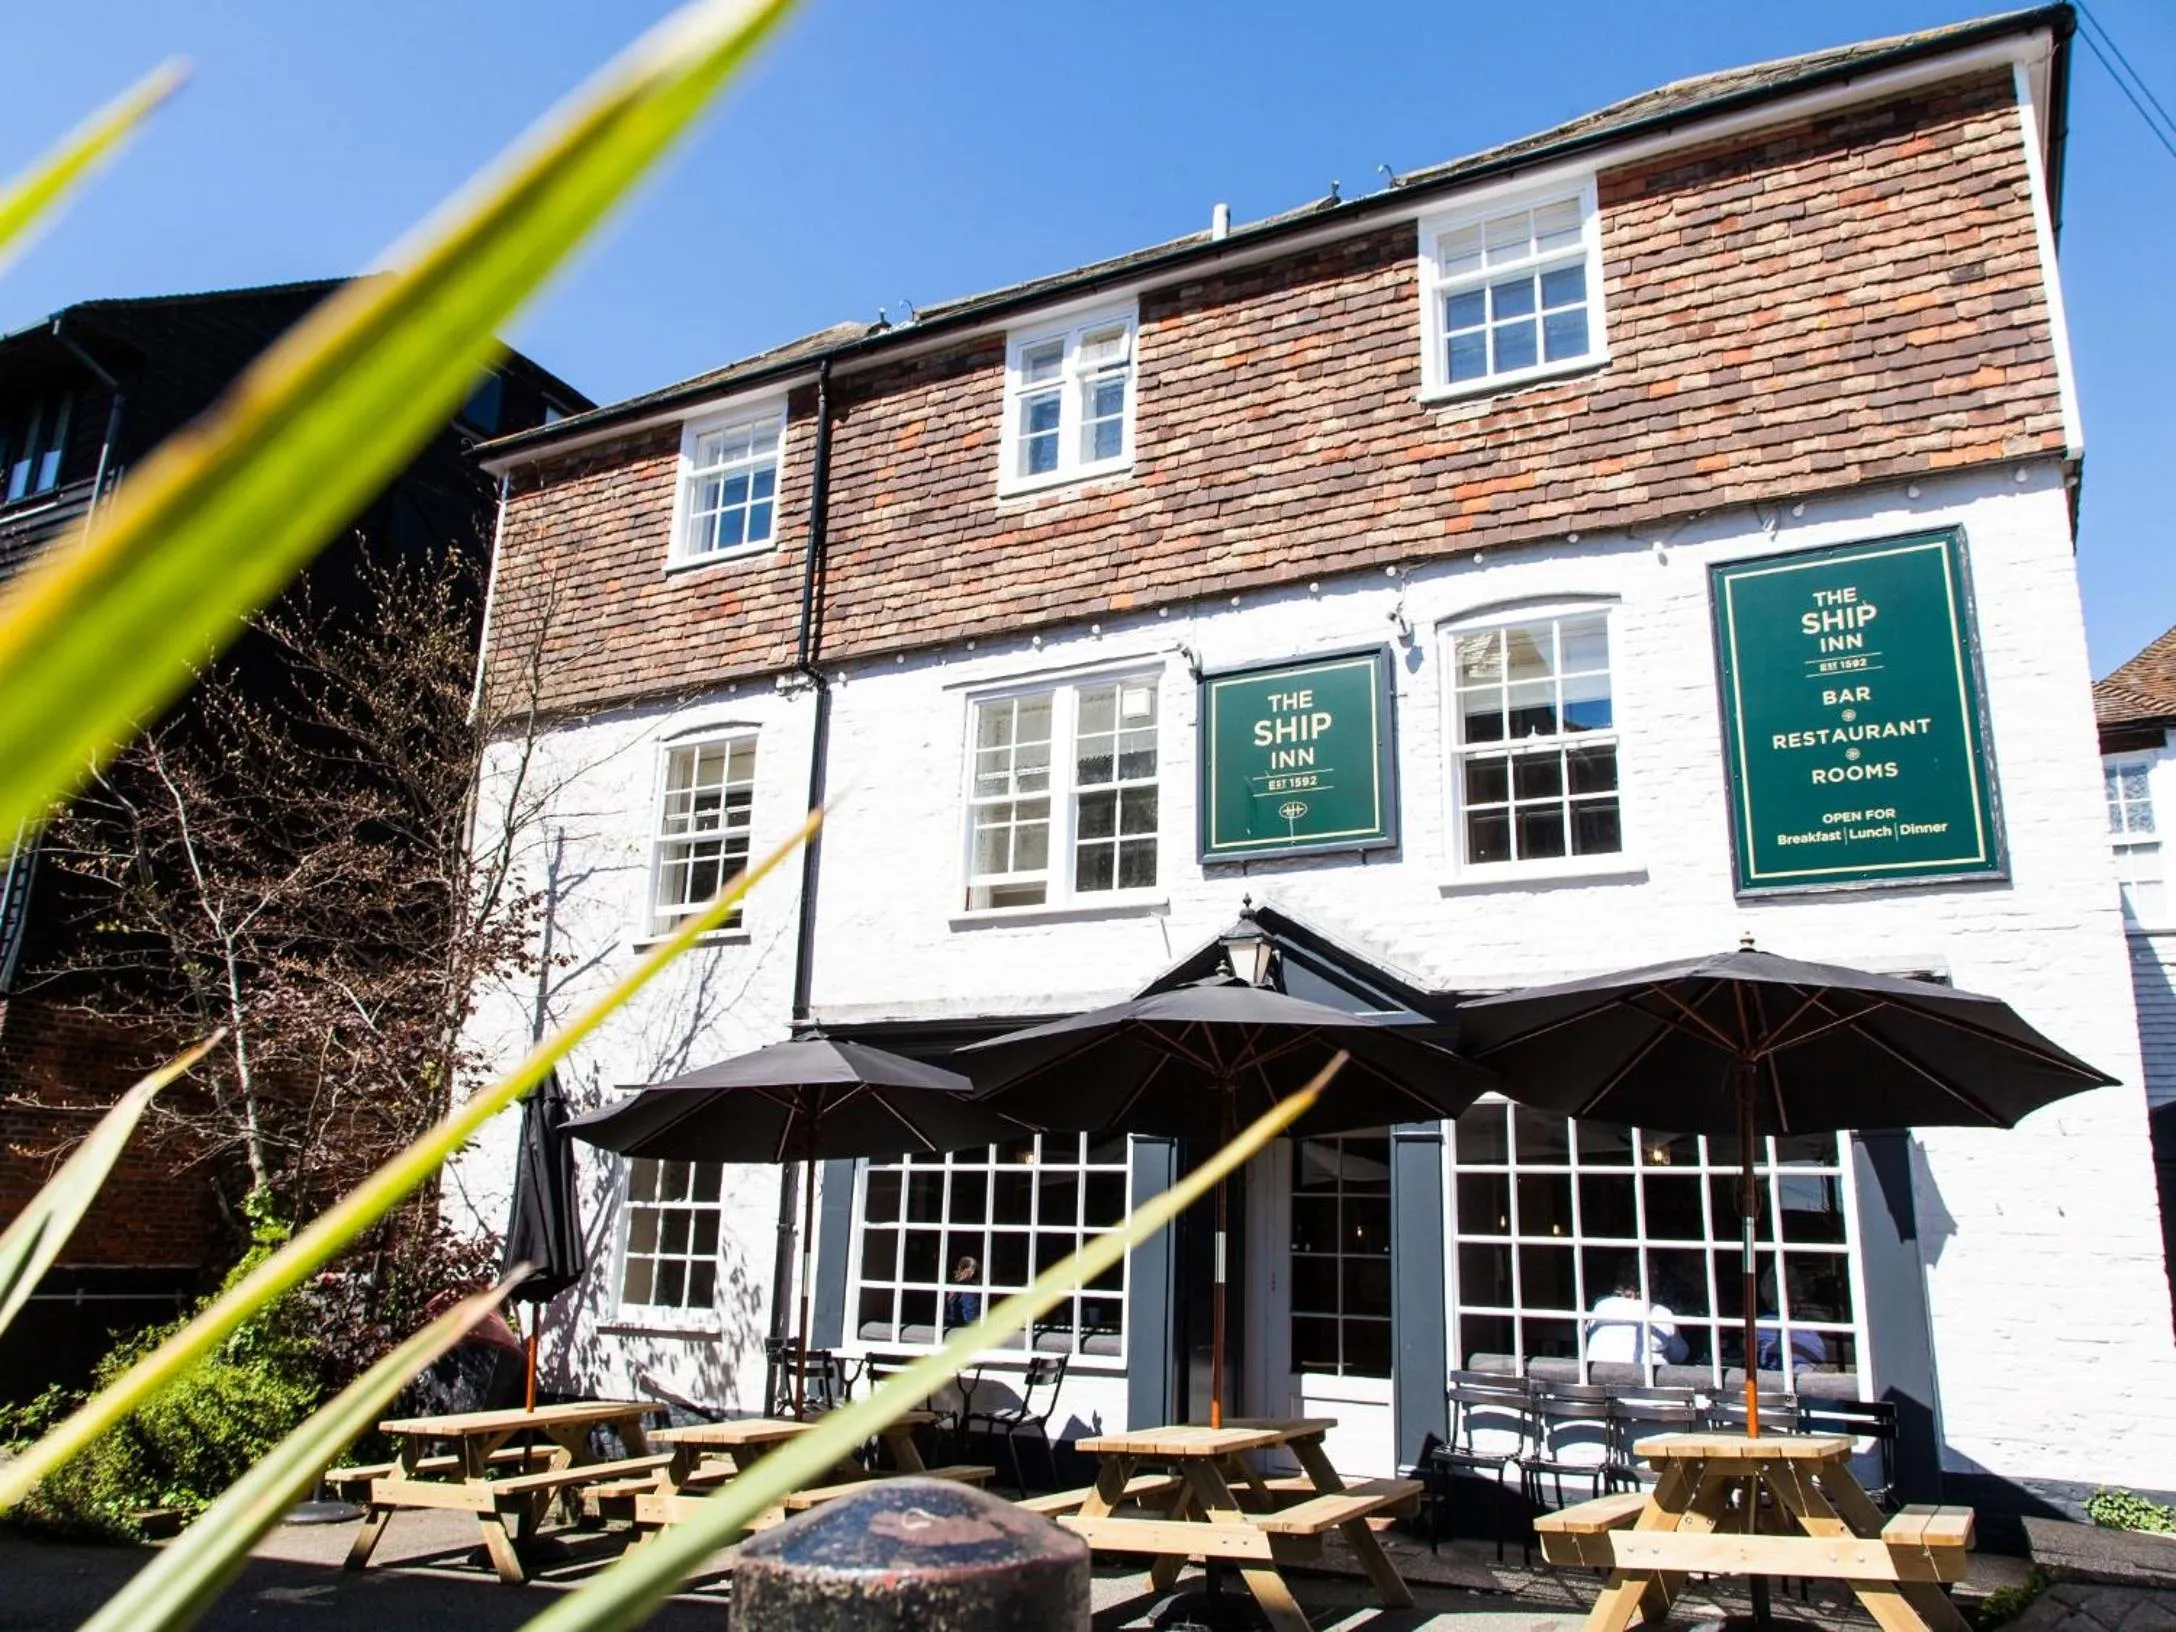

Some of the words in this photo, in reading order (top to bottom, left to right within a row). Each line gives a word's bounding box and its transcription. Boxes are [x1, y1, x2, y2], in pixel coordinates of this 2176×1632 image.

[1813, 587, 1857, 608] THE
[1801, 604, 1877, 636] SHIP
[1819, 633, 1863, 653] INN
[1839, 658, 1868, 669] 1592
[1267, 690, 1313, 712] THE
[1822, 686, 1871, 706] BAR
[1253, 712, 1333, 747] SHIP
[1772, 718, 1931, 750] RESTAURANT
[1271, 747, 1314, 770] INN
[1268, 779, 1287, 790] EST
[1289, 775, 1318, 788] 1592
[1811, 762, 1899, 784] ROOMS
[1822, 811, 1862, 824] OPEN
[1865, 808, 1896, 821] FOR
[1777, 830, 1842, 846] Breakfast
[1848, 826, 1893, 840] Lunch
[1899, 822, 1948, 836] Dinner
